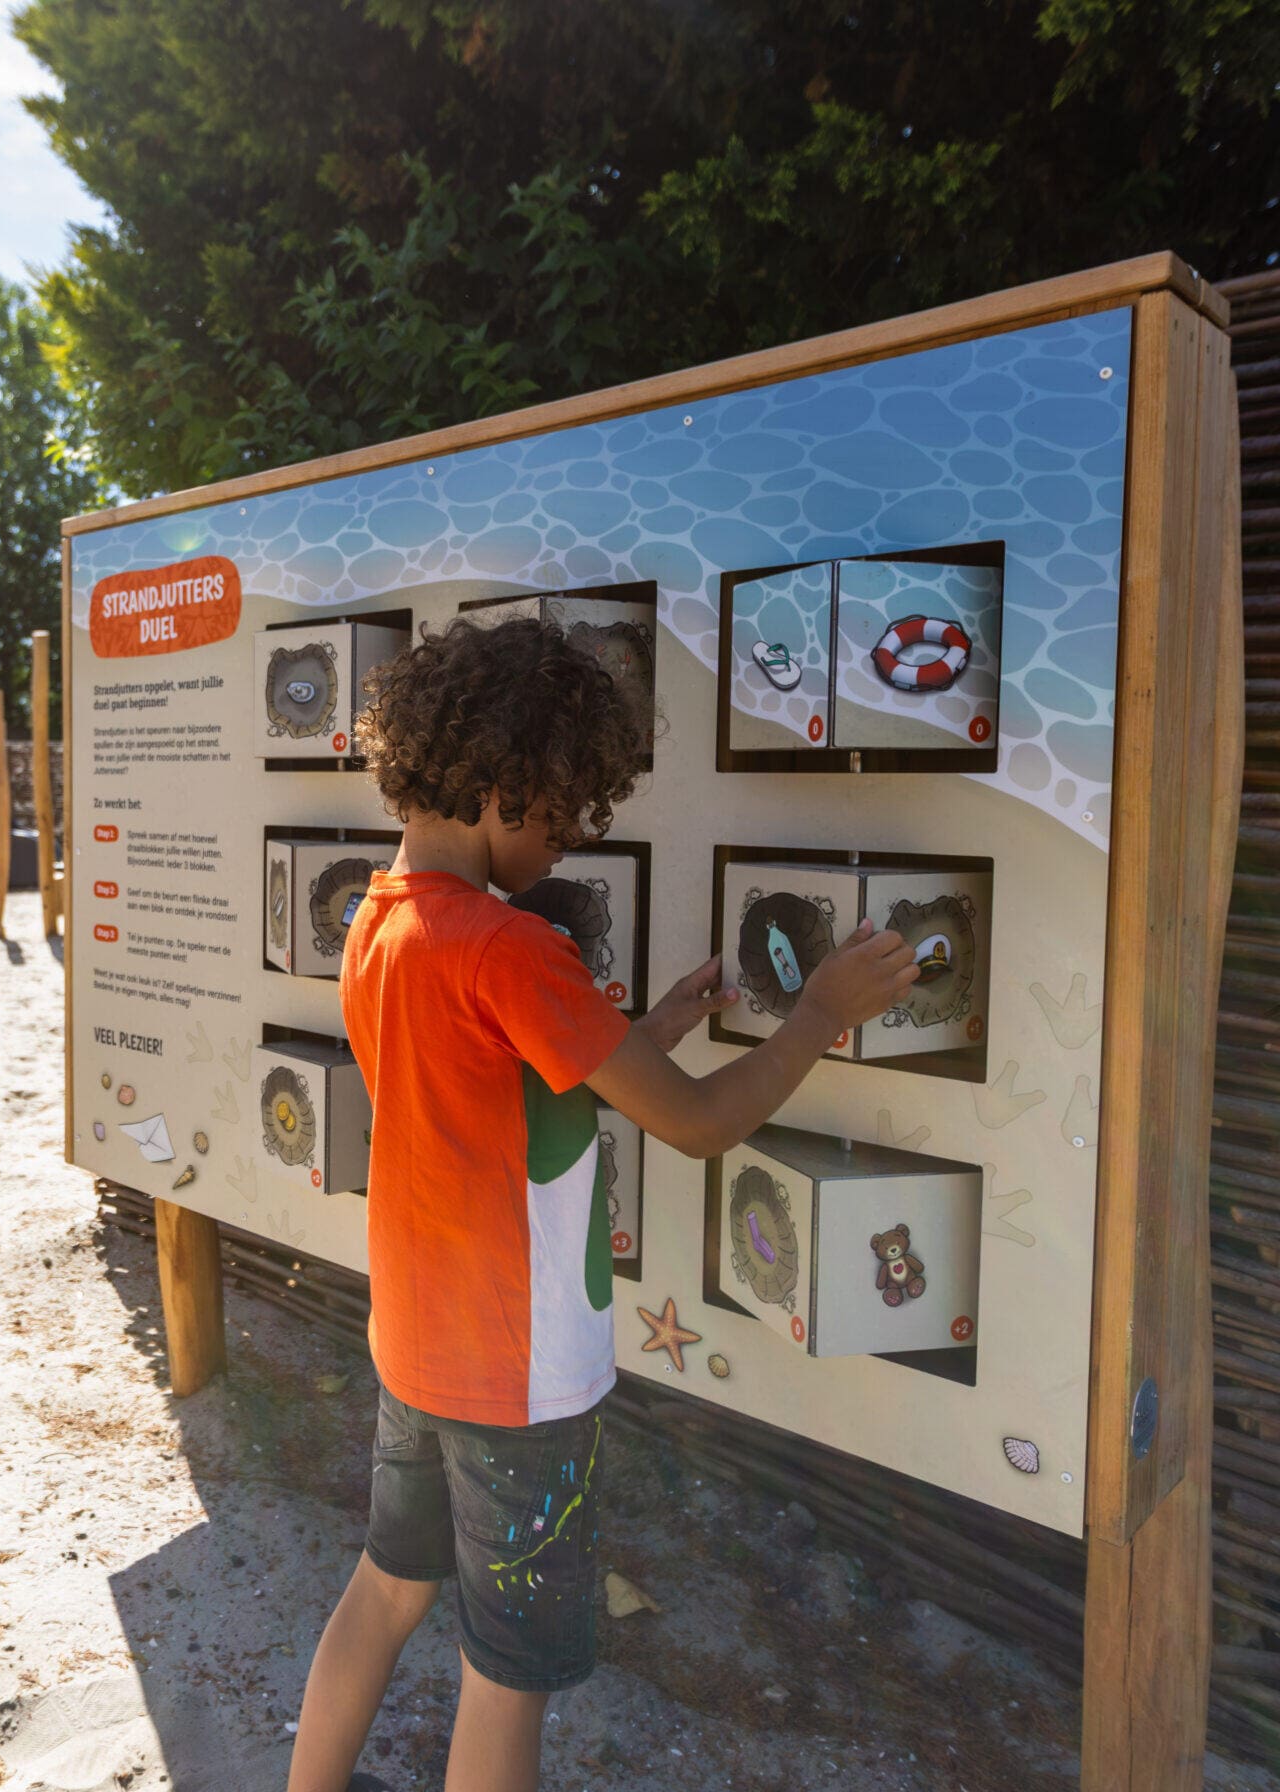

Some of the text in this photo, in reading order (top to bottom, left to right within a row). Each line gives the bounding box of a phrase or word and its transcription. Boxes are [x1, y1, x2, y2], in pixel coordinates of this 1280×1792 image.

[102, 573, 225, 619] STRANDJUTTERS
[139, 615, 178, 645] DUEL
[94, 676, 224, 696] Strandjutters opgelet, want jullie
[93, 696, 168, 712] duel gaat beginnen!
[135, 726, 145, 735] het
[172, 726, 186, 734] naar
[187, 724, 222, 735] bijzondere
[813, 722, 819, 735] 0
[976, 723, 983, 736] 0
[124, 740, 135, 750] zijn
[136, 739, 175, 751] aangespoeld
[176, 740, 185, 749] op
[185, 739, 197, 748] het
[197, 738, 219, 748] strand.
[147, 753, 154, 762] de
[156, 753, 181, 761] mooiste
[182, 753, 210, 761] schatten
[211, 752, 219, 761] in
[219, 752, 231, 761] het
[94, 797, 103, 808] Zo
[104, 797, 126, 809] werkt
[127, 830, 218, 844] Spreek samen af met hoeveel
[166, 846, 181, 857] jullie
[182, 847, 201, 857] willen
[202, 848, 223, 860] jutten.
[127, 887, 229, 908] Geef om de beurt een flinke draai
[127, 902, 238, 923] aan een blok en ontdek je vondsten!
[127, 932, 136, 942] Tel
[137, 933, 143, 943] je
[144, 935, 165, 946] punten
[177, 939, 186, 949] De
[187, 941, 207, 953] speler
[208, 945, 221, 955] met
[222, 946, 232, 956] de
[150, 948, 171, 960] punten
[108, 970, 114, 980] je
[115, 972, 125, 981] wat
[127, 973, 138, 983] ook
[138, 975, 151, 987] leuk
[162, 979, 175, 991] Zelf
[207, 989, 242, 1003] verzinnen!
[115, 984, 121, 995] je
[122, 985, 138, 998] eigen
[160, 992, 174, 1003] alles
[609, 987, 623, 999] +5
[93, 1026, 163, 1056] VEEL PLEZIER!
[615, 1237, 628, 1248] +3
[954, 1322, 969, 1335] +2
